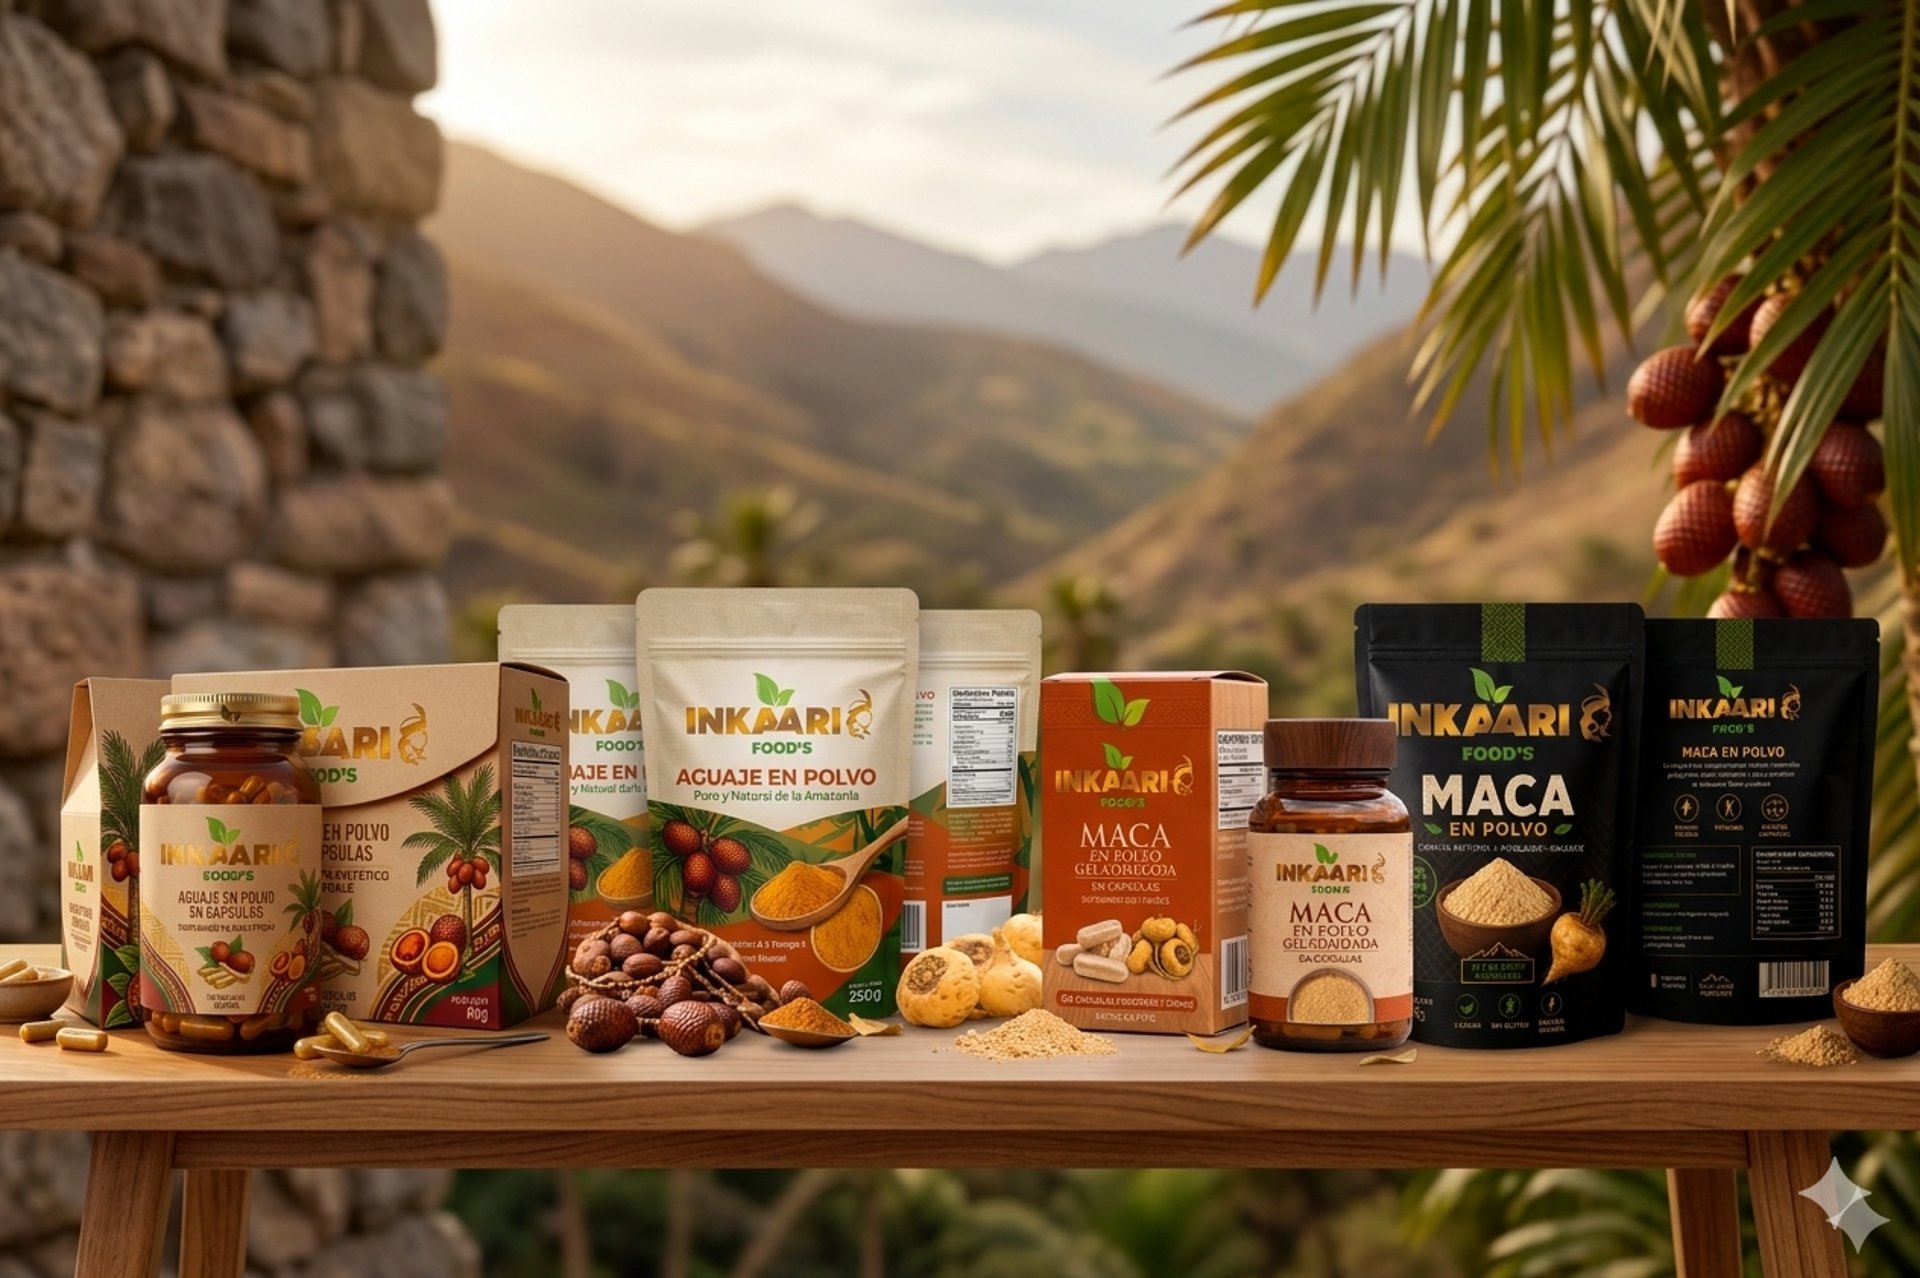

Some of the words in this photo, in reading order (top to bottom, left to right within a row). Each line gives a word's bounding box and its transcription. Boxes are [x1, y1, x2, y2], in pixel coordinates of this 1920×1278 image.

[1669, 698, 1776, 719] INKAARI
[685, 707, 841, 735] INKAARI
[1387, 703, 1571, 737] INKAARI
[751, 741, 813, 754] FOOD'S
[1462, 746, 1535, 762] FOOD'S
[1721, 746, 1739, 758] EN
[1742, 746, 1786, 758] POLVO
[612, 764, 637, 780] EN
[675, 768, 762, 786] AGUAJE
[768, 768, 797, 785] EN
[803, 767, 877, 786] POLVO
[1055, 769, 1169, 793] INKAARI
[721, 792, 731, 804] y
[774, 790, 789, 801] de
[1422, 774, 1575, 817] MACA
[1080, 822, 1171, 848] MACA
[1449, 822, 1475, 837] EN
[1483, 821, 1548, 838] POLVO
[1276, 863, 1368, 882] INKAARI
[1289, 901, 1372, 923] MACA
[1293, 925, 1313, 937] EN
